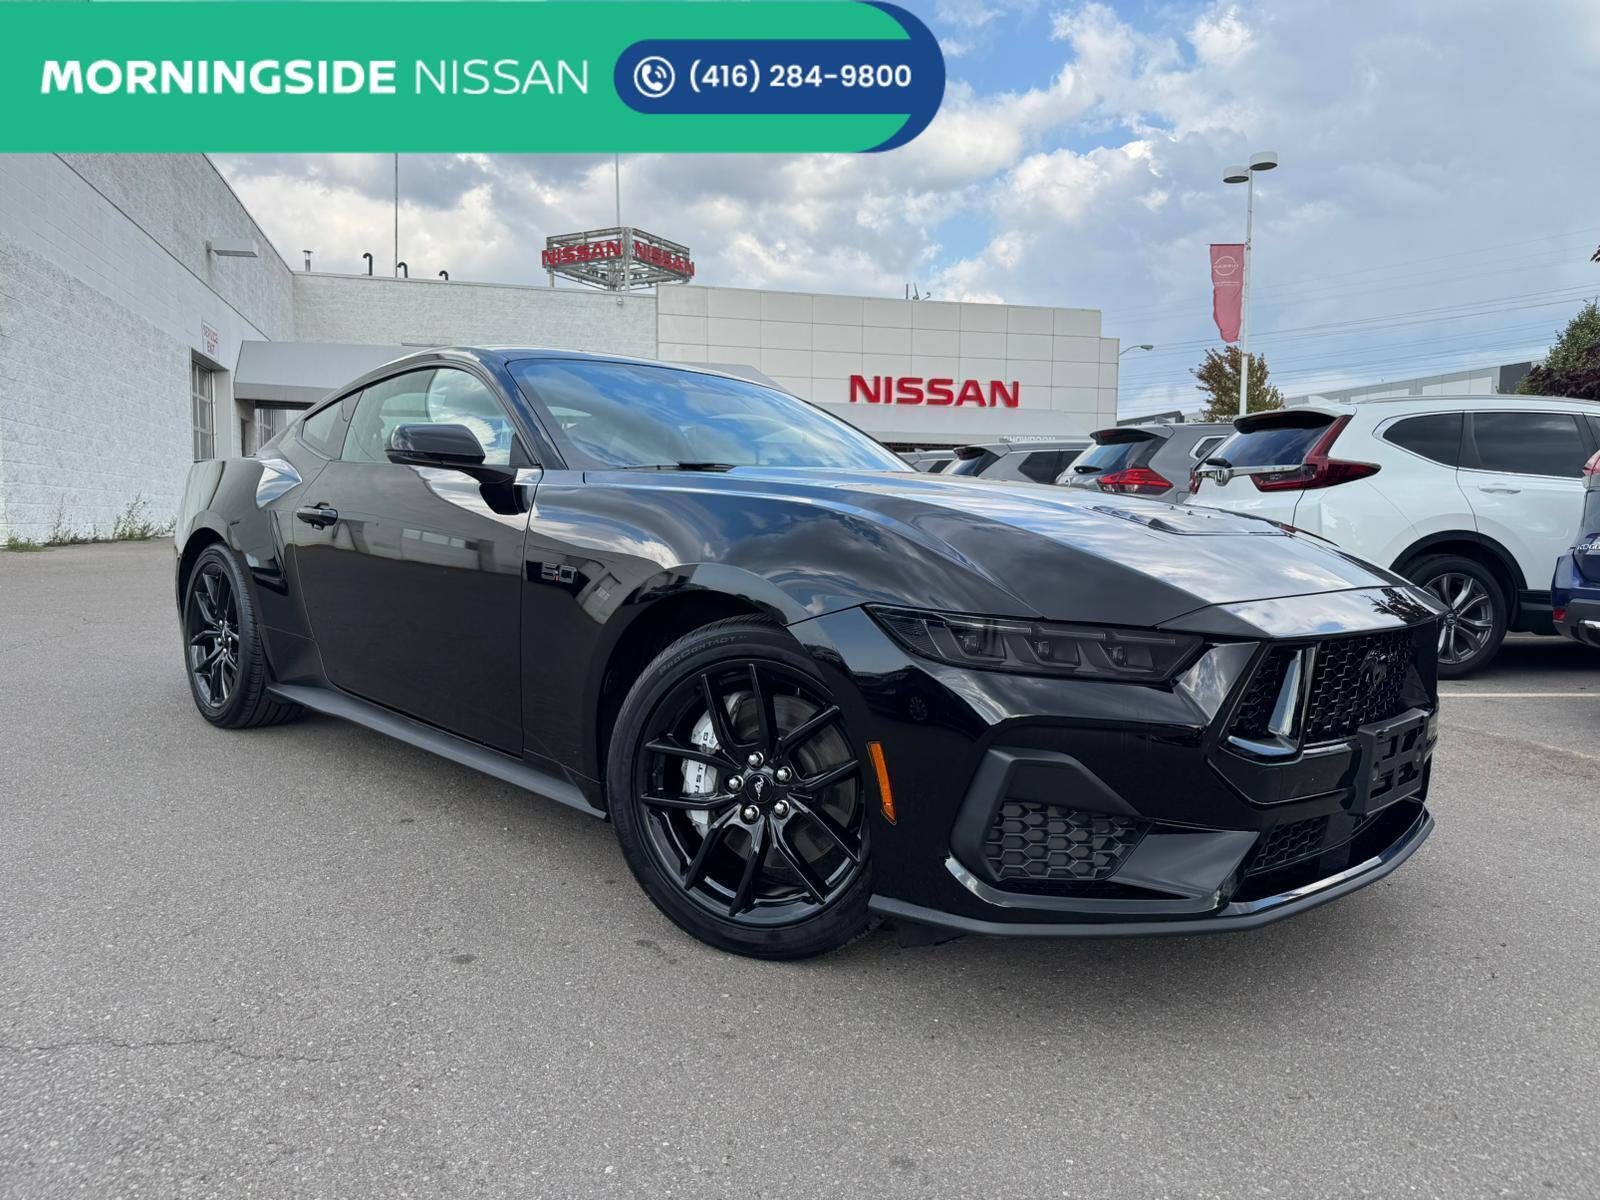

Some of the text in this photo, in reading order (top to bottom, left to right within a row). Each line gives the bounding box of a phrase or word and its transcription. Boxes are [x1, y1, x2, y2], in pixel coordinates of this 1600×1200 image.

[541, 240, 622, 269] NISSAN
[635, 240, 695, 277] NISSAN
[849, 374, 1020, 409] NISSAN
[541, 561, 577, 584] 5.0
[694, 731, 709, 794] USTNG
